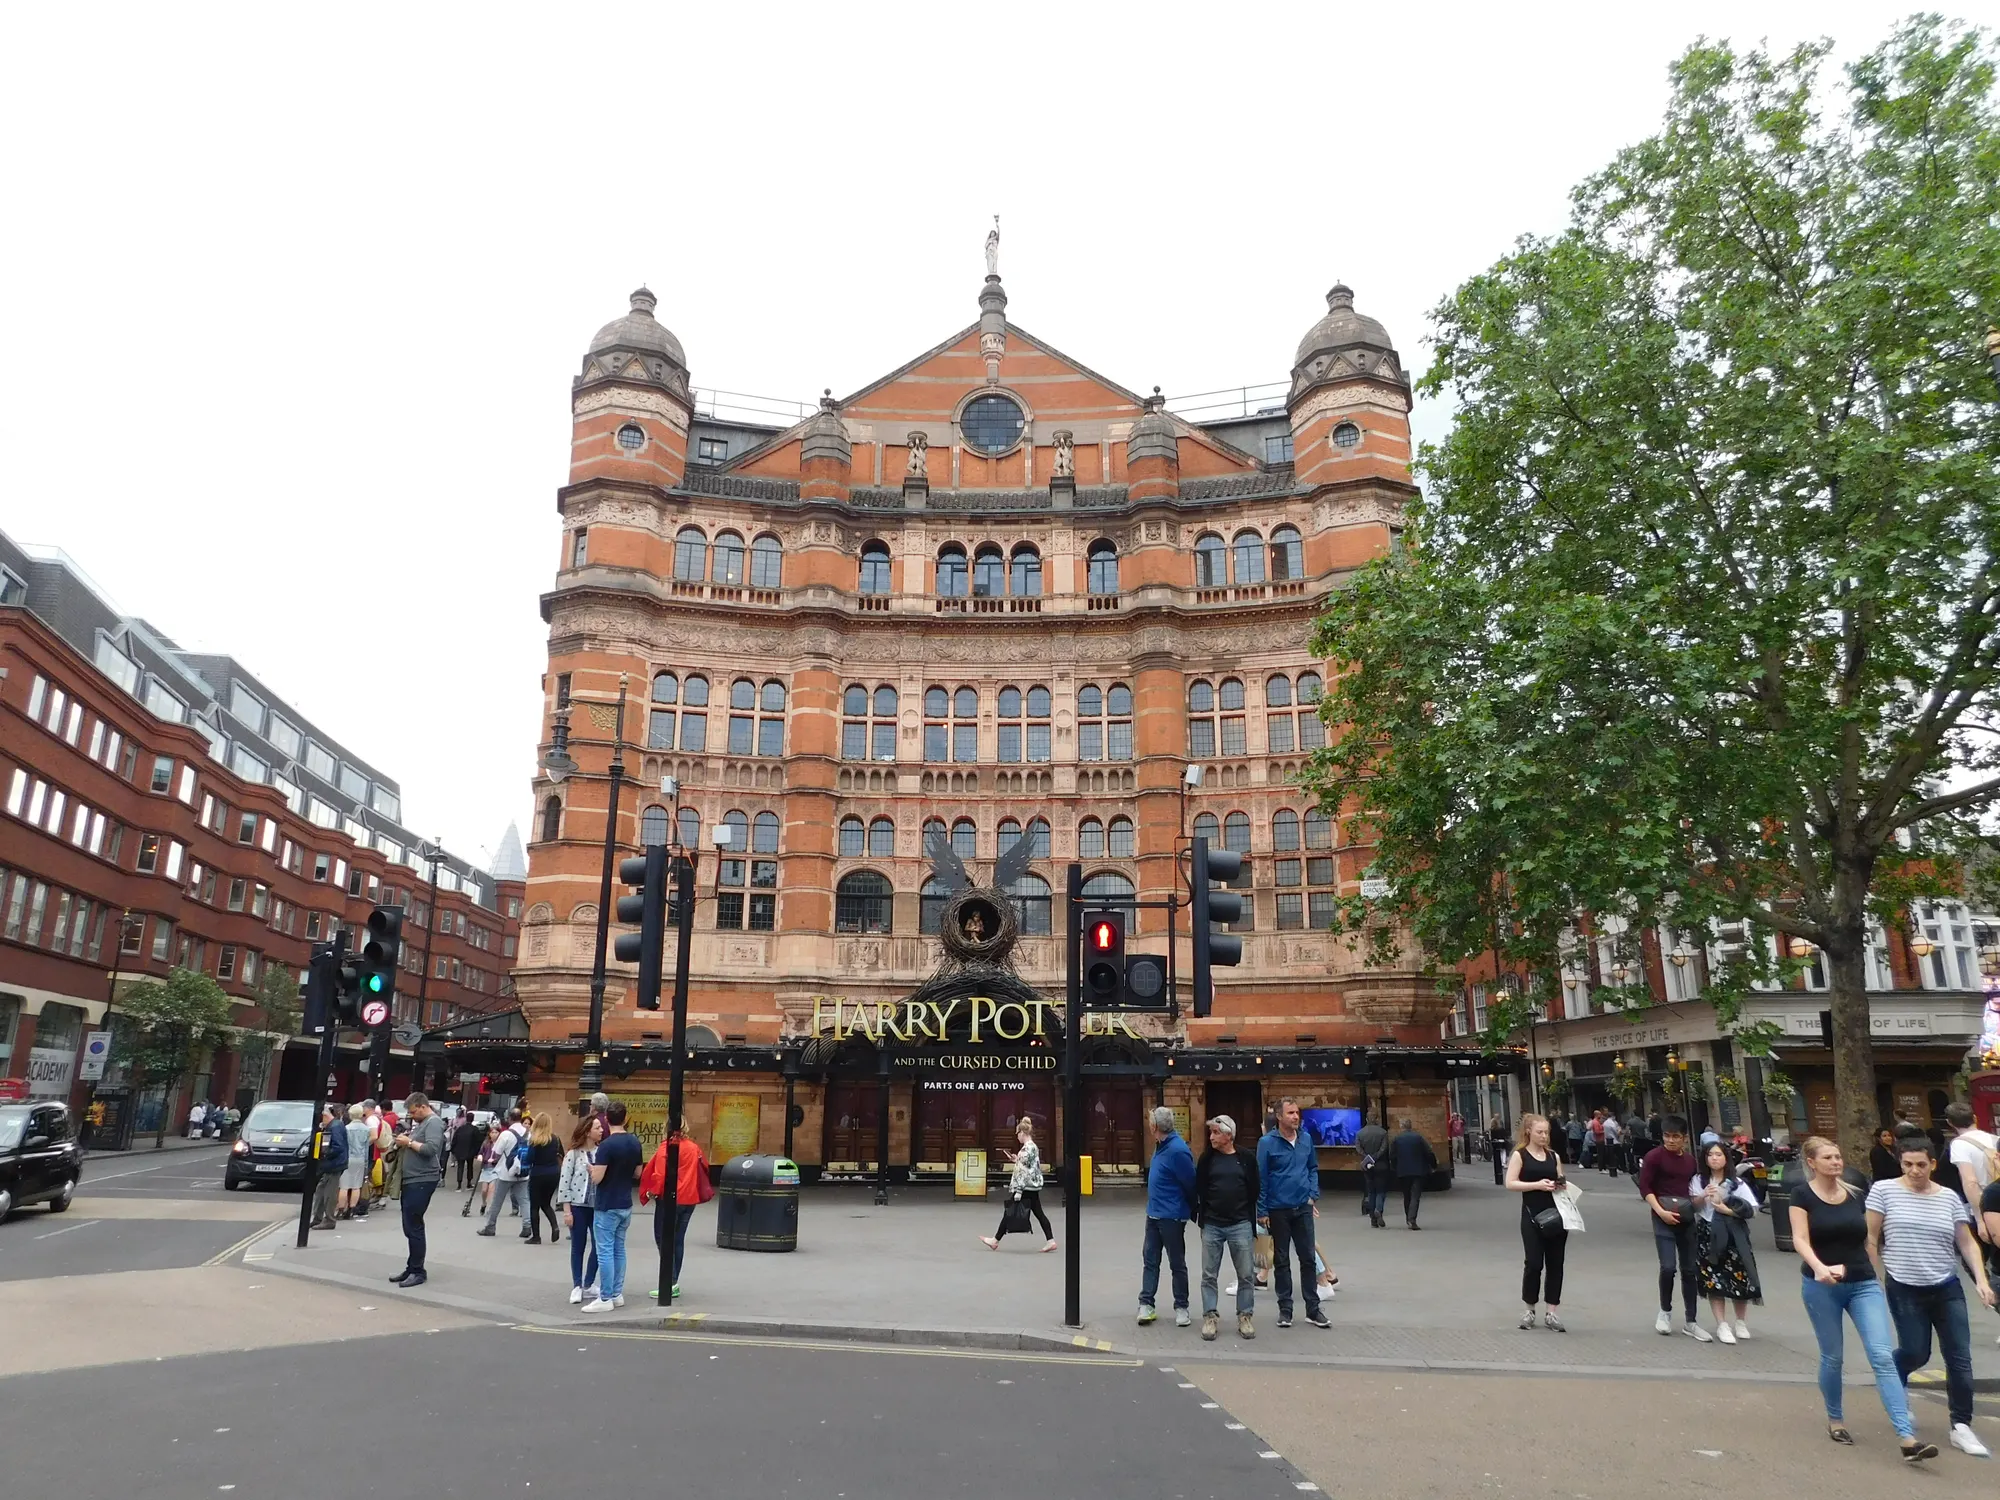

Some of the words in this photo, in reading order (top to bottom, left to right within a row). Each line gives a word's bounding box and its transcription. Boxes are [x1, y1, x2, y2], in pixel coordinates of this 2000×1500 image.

[810, 995, 961, 1042] HARRY
[1795, 1019, 1823, 1028] THE
[1872, 1019, 1891, 1028] OF
[1897, 1019, 1927, 1028] LIFE
[1592, 1036, 1607, 1048] THE
[1609, 1033, 1633, 1046] SPICE
[1635, 1031, 1647, 1043] OF
[1649, 1028, 1669, 1041] LIFE
[893, 1057, 916, 1066] AND
[917, 1057, 936, 1066] THE
[939, 1055, 1001, 1070] CURSED
[1005, 1055, 1057, 1069] CHILD
[26, 1061, 69, 1082] ACADEMY
[923, 1081, 952, 1090] PARTS
[955, 1082, 975, 1090] ONE
[977, 1082, 999, 1090] AND
[1001, 1082, 1025, 1090] TWO
[634, 1121, 664, 1133] HAR
